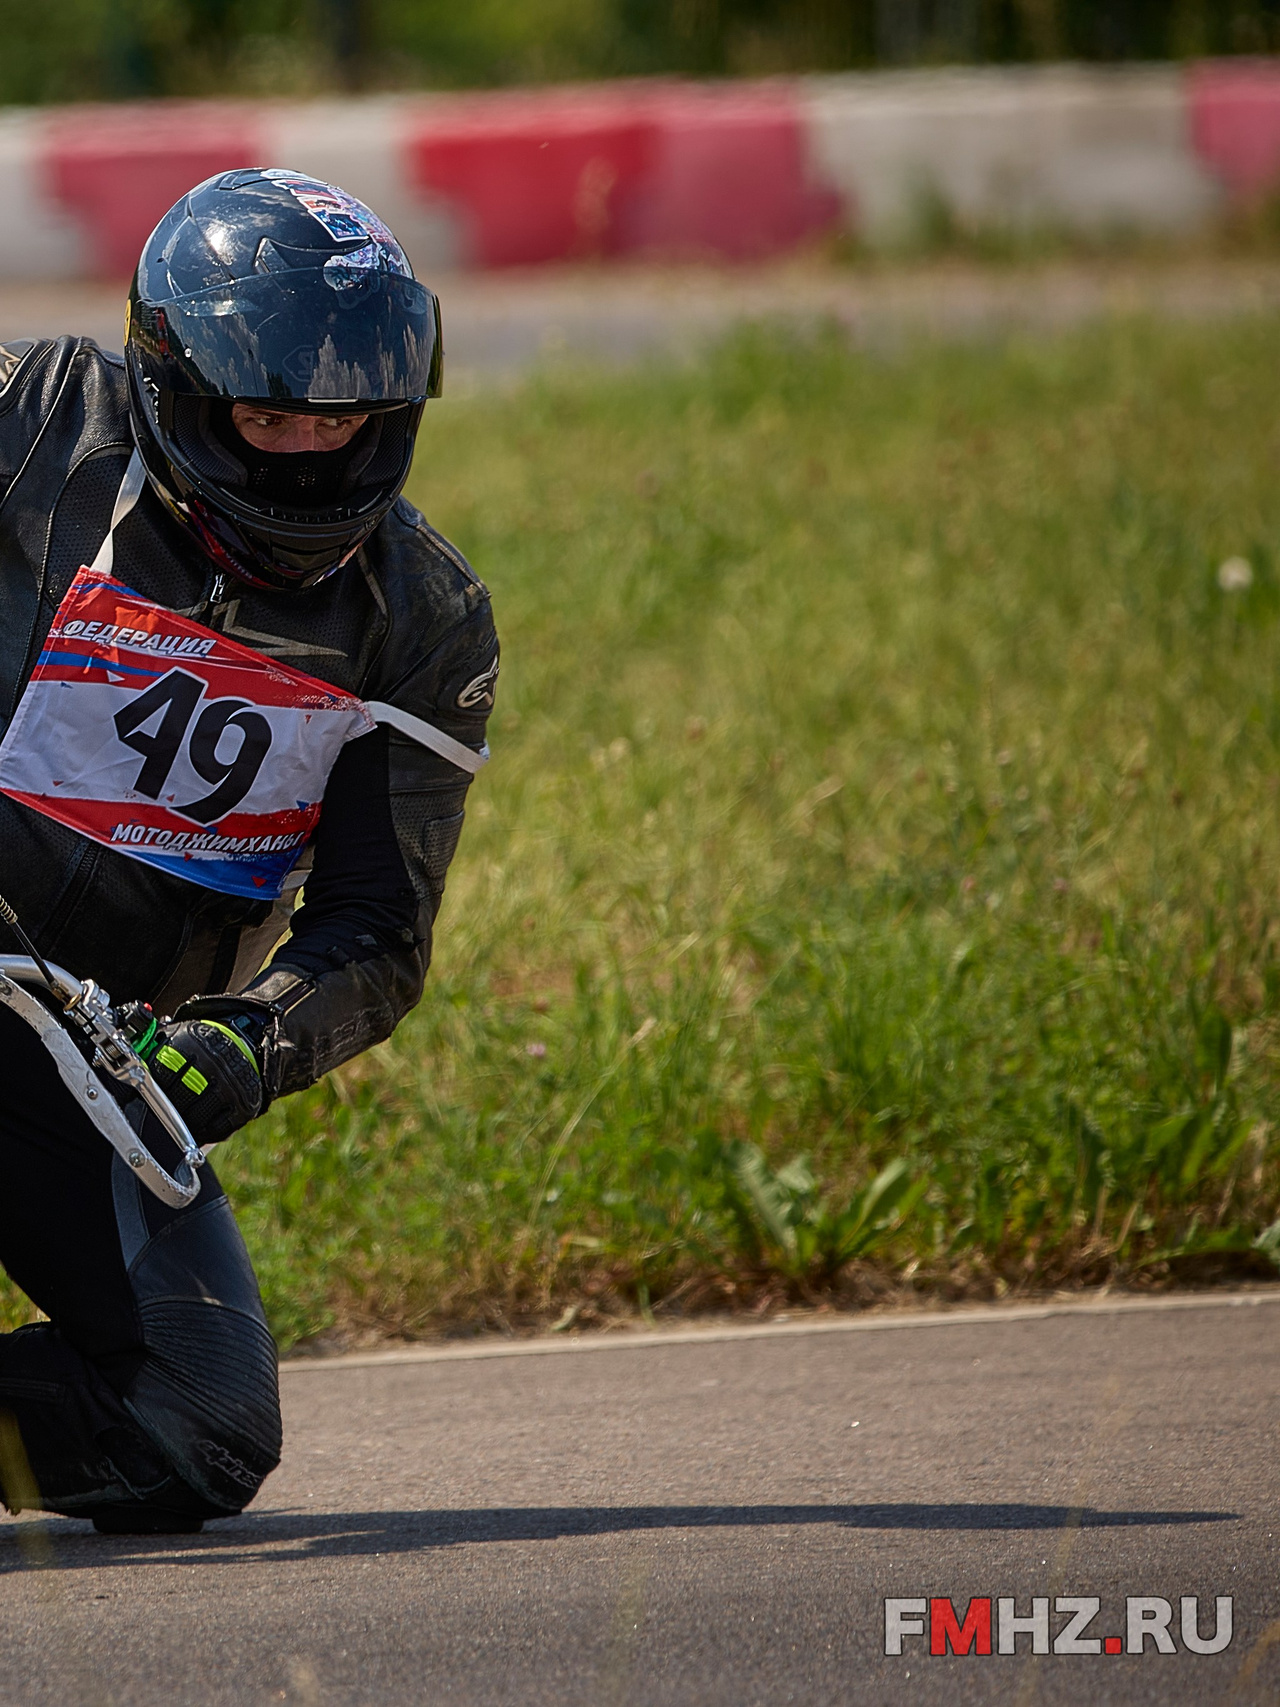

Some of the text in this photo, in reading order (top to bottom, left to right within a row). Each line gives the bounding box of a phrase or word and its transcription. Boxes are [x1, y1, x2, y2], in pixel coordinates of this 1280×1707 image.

[63, 620, 217, 656] ФЕДЕРАЦИЯ
[113, 667, 272, 826] 49
[110, 823, 305, 851] МОТОДЖИМХАНЫ
